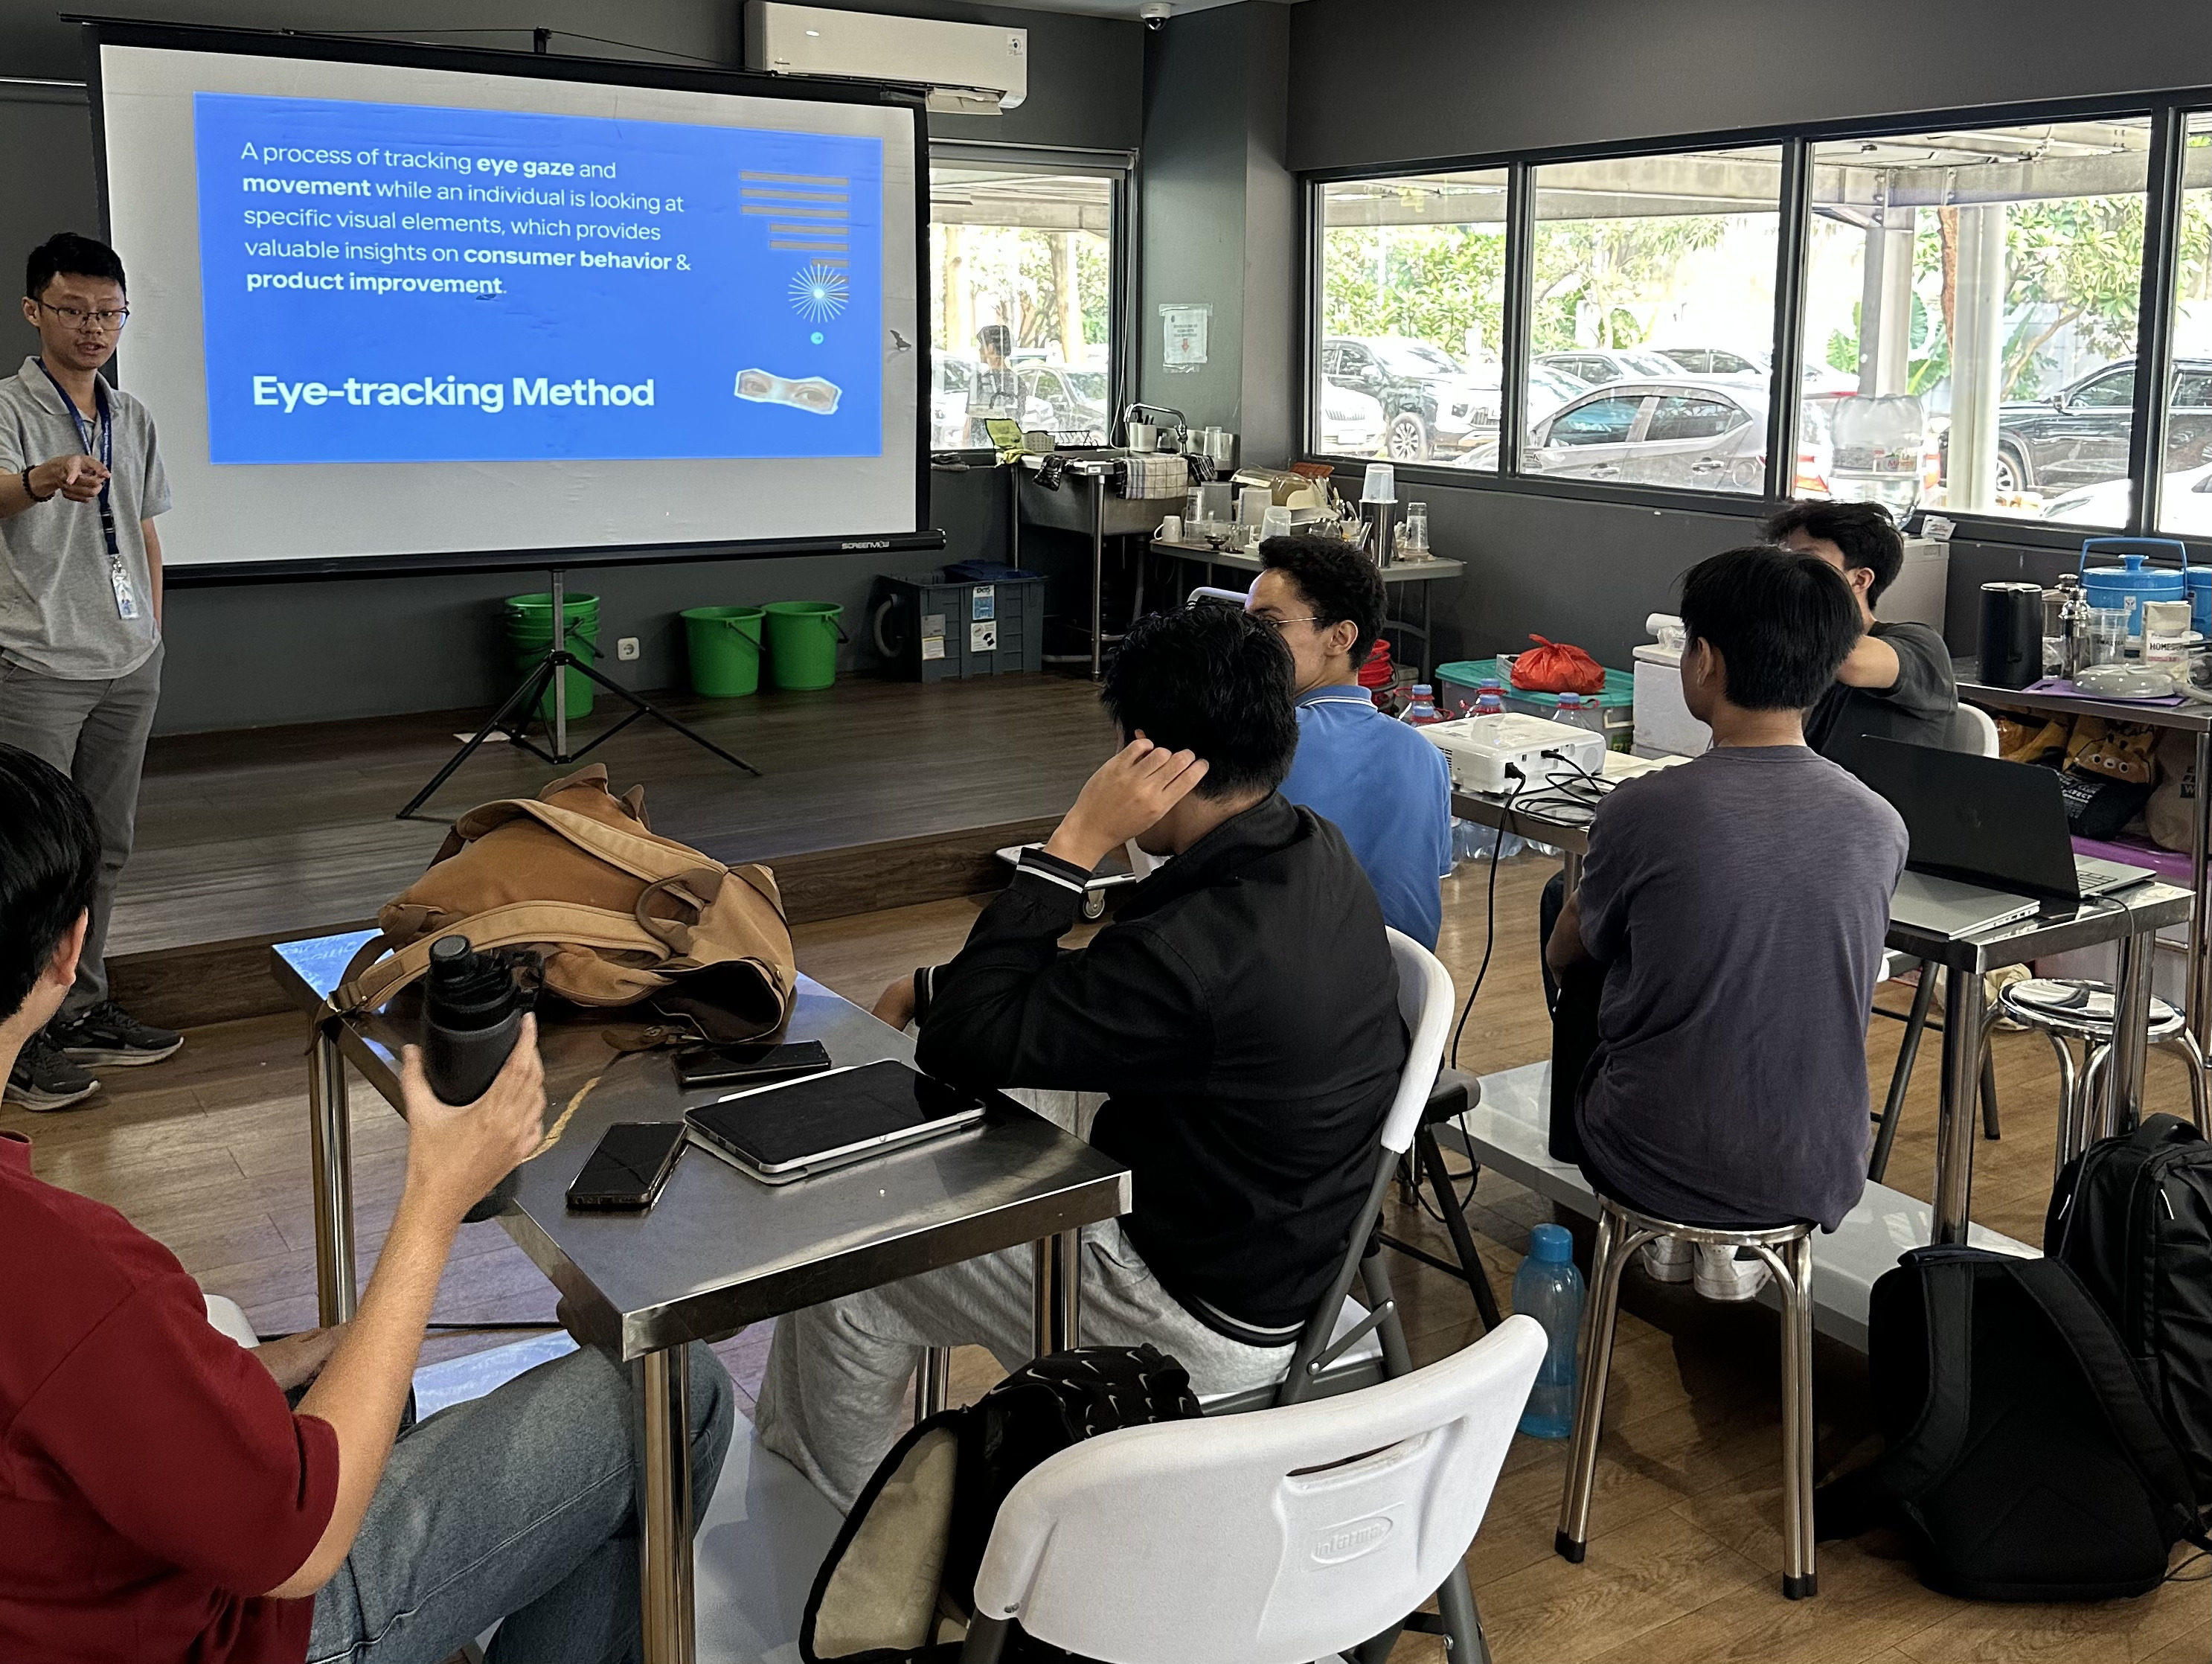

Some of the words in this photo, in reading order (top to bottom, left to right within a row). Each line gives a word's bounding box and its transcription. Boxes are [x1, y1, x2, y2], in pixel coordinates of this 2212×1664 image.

[241, 142, 259, 161] A
[263, 146, 352, 165] process
[356, 147, 380, 165] of
[383, 150, 472, 176] tracking
[476, 158, 519, 177] eye
[522, 161, 575, 179] gaze
[579, 161, 616, 179] and
[243, 177, 372, 196] movement
[375, 180, 432, 199] while
[436, 186, 463, 201] an
[468, 184, 565, 206] individual
[570, 190, 586, 208] is
[590, 191, 661, 215] looking
[664, 196, 685, 213] at
[243, 208, 332, 229] specific
[336, 210, 397, 229] visual
[401, 212, 506, 236] elements,
[510, 218, 571, 237] which
[576, 222, 661, 241] provides
[244, 238, 340, 259] valuable
[344, 241, 427, 265] insights
[432, 248, 459, 262] on
[464, 249, 577, 266] consumer
[580, 250, 673, 270] behavior
[676, 254, 691, 271] &
[246, 271, 344, 292] product
[349, 272, 507, 295] improvement.
[253, 374, 504, 413] Eye-tracking
[513, 377, 655, 406] Method
